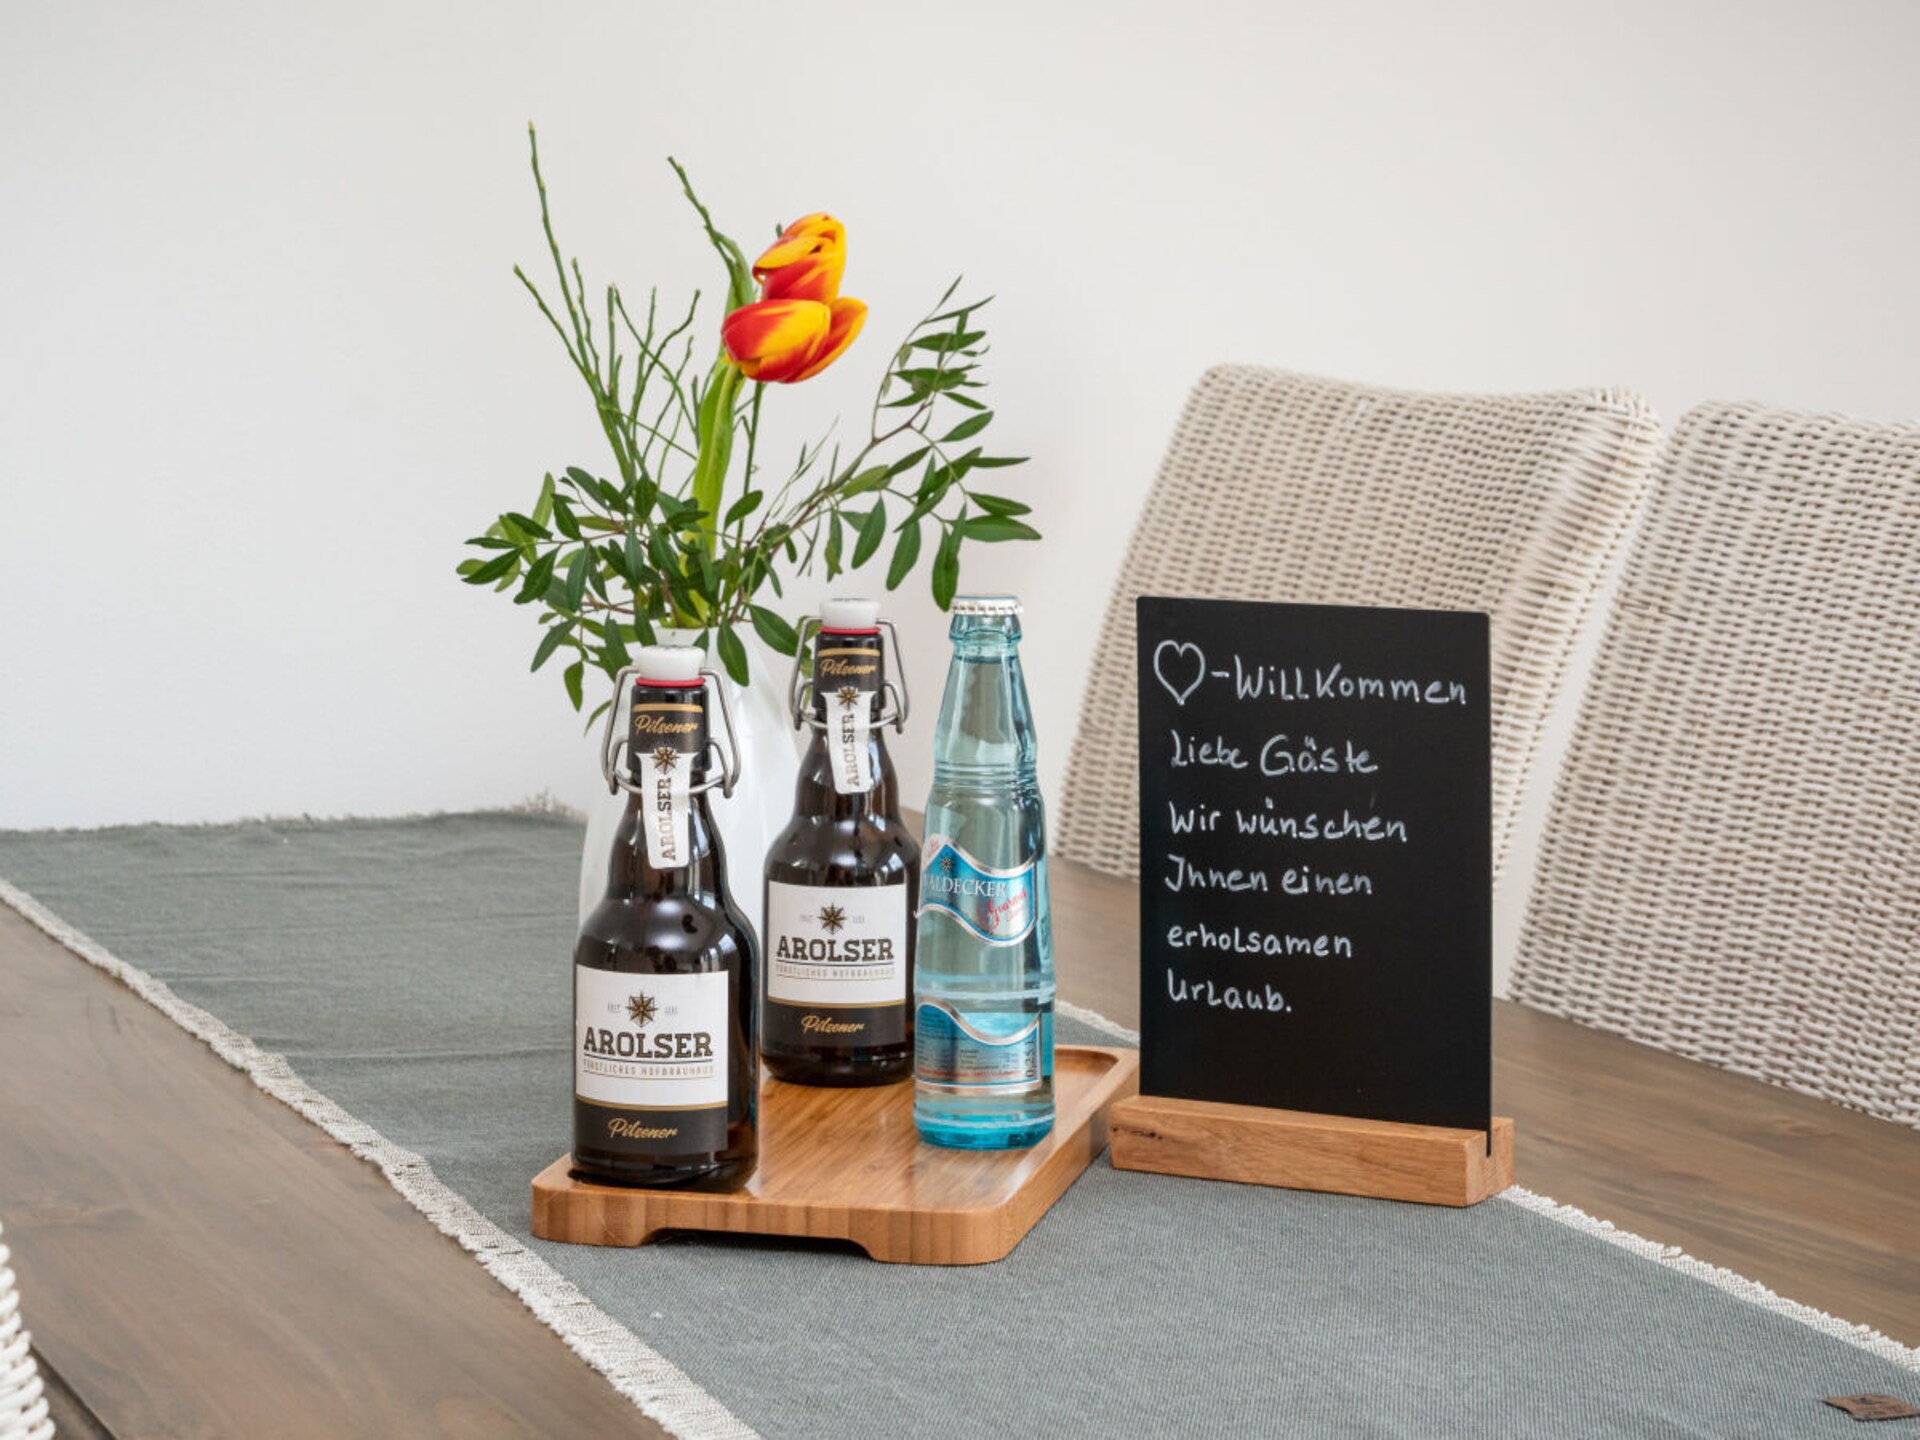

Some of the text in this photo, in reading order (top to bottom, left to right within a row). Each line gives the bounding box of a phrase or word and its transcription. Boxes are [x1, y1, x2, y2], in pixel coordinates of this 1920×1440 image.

[820, 658, 876, 677] Pilsener
[633, 714, 698, 735] Pilsener
[842, 713, 859, 787] AROLSER
[1171, 730, 1378, 776] Liebe Gäste
[657, 777, 676, 861] AROLSER
[1169, 797, 1408, 842] Wir wünschen
[924, 871, 1007, 897] ALDECKER
[1281, 866, 1372, 895] einen
[776, 935, 894, 962] AROLSER
[801, 1015, 865, 1034] Pilsener
[583, 1027, 713, 1059] AROLSER
[607, 1117, 678, 1138] Pilsener
